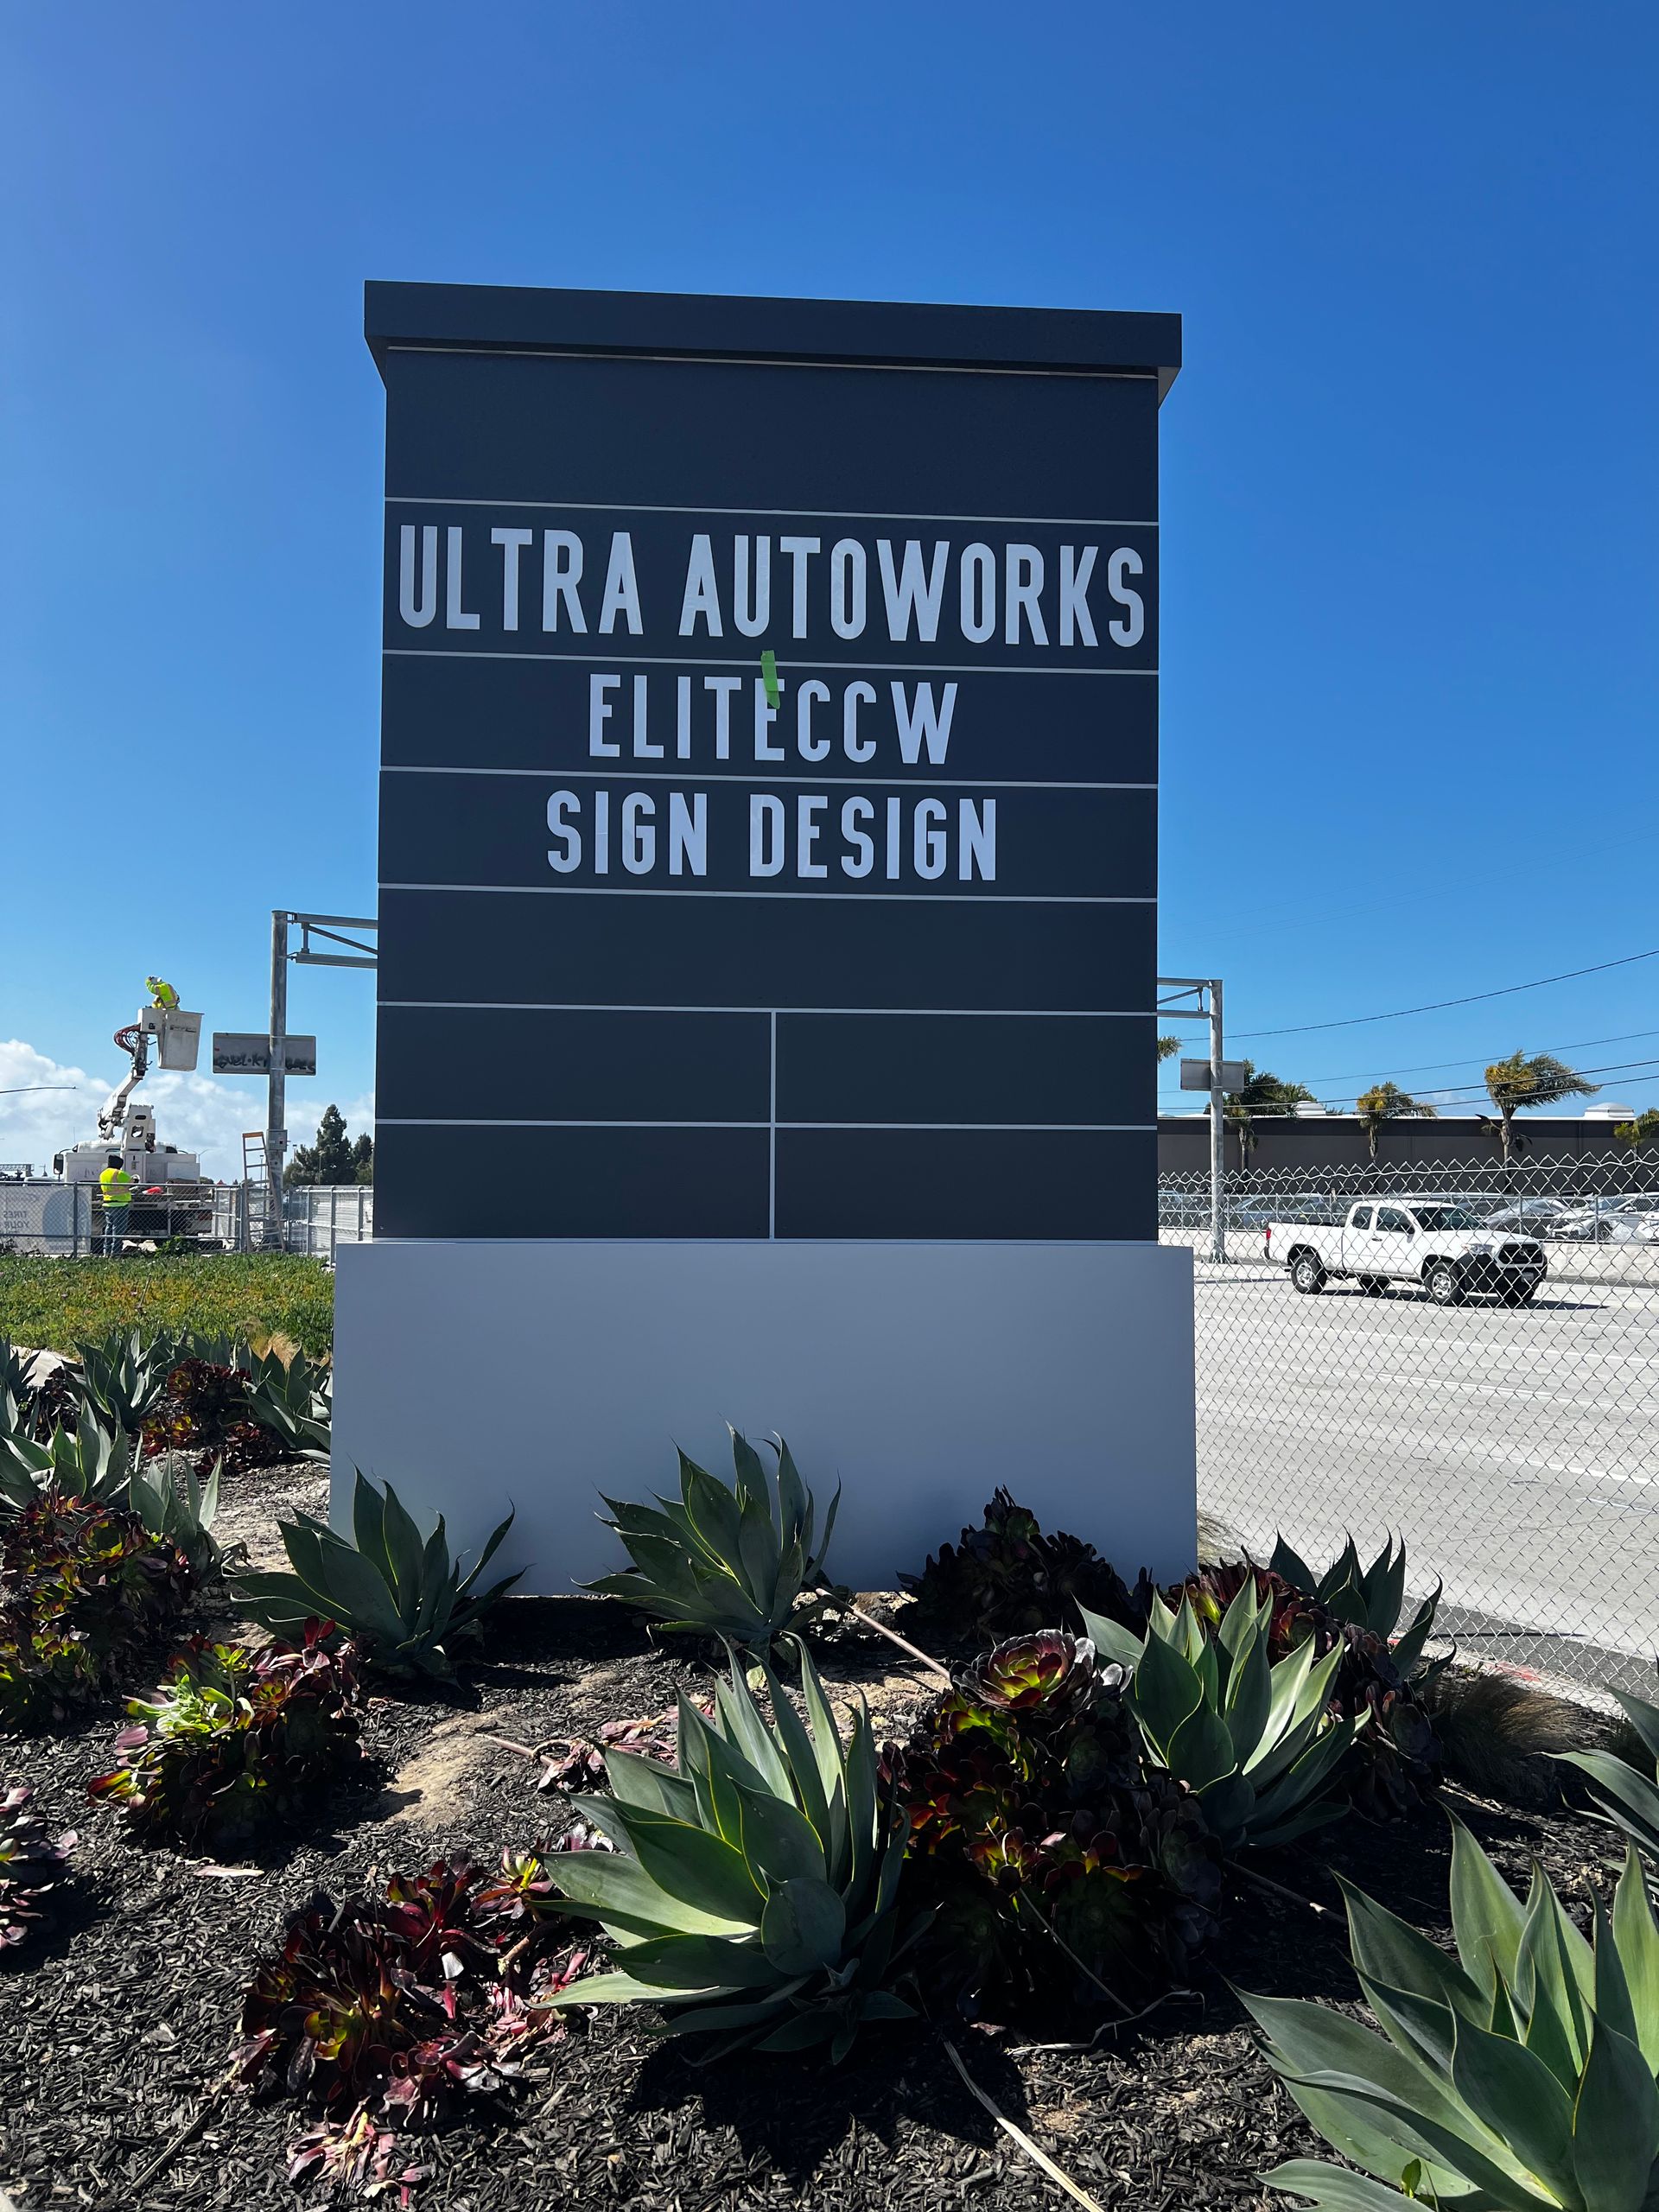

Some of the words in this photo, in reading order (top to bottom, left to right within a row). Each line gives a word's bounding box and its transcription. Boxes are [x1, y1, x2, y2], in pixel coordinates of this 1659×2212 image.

[399, 524, 644, 635] ULTRA
[678, 534, 1144, 647] AUTOWORKS
[589, 673, 958, 765] ELITECCW
[547, 790, 708, 876] SIGN
[749, 794, 996, 881] DESIGN
